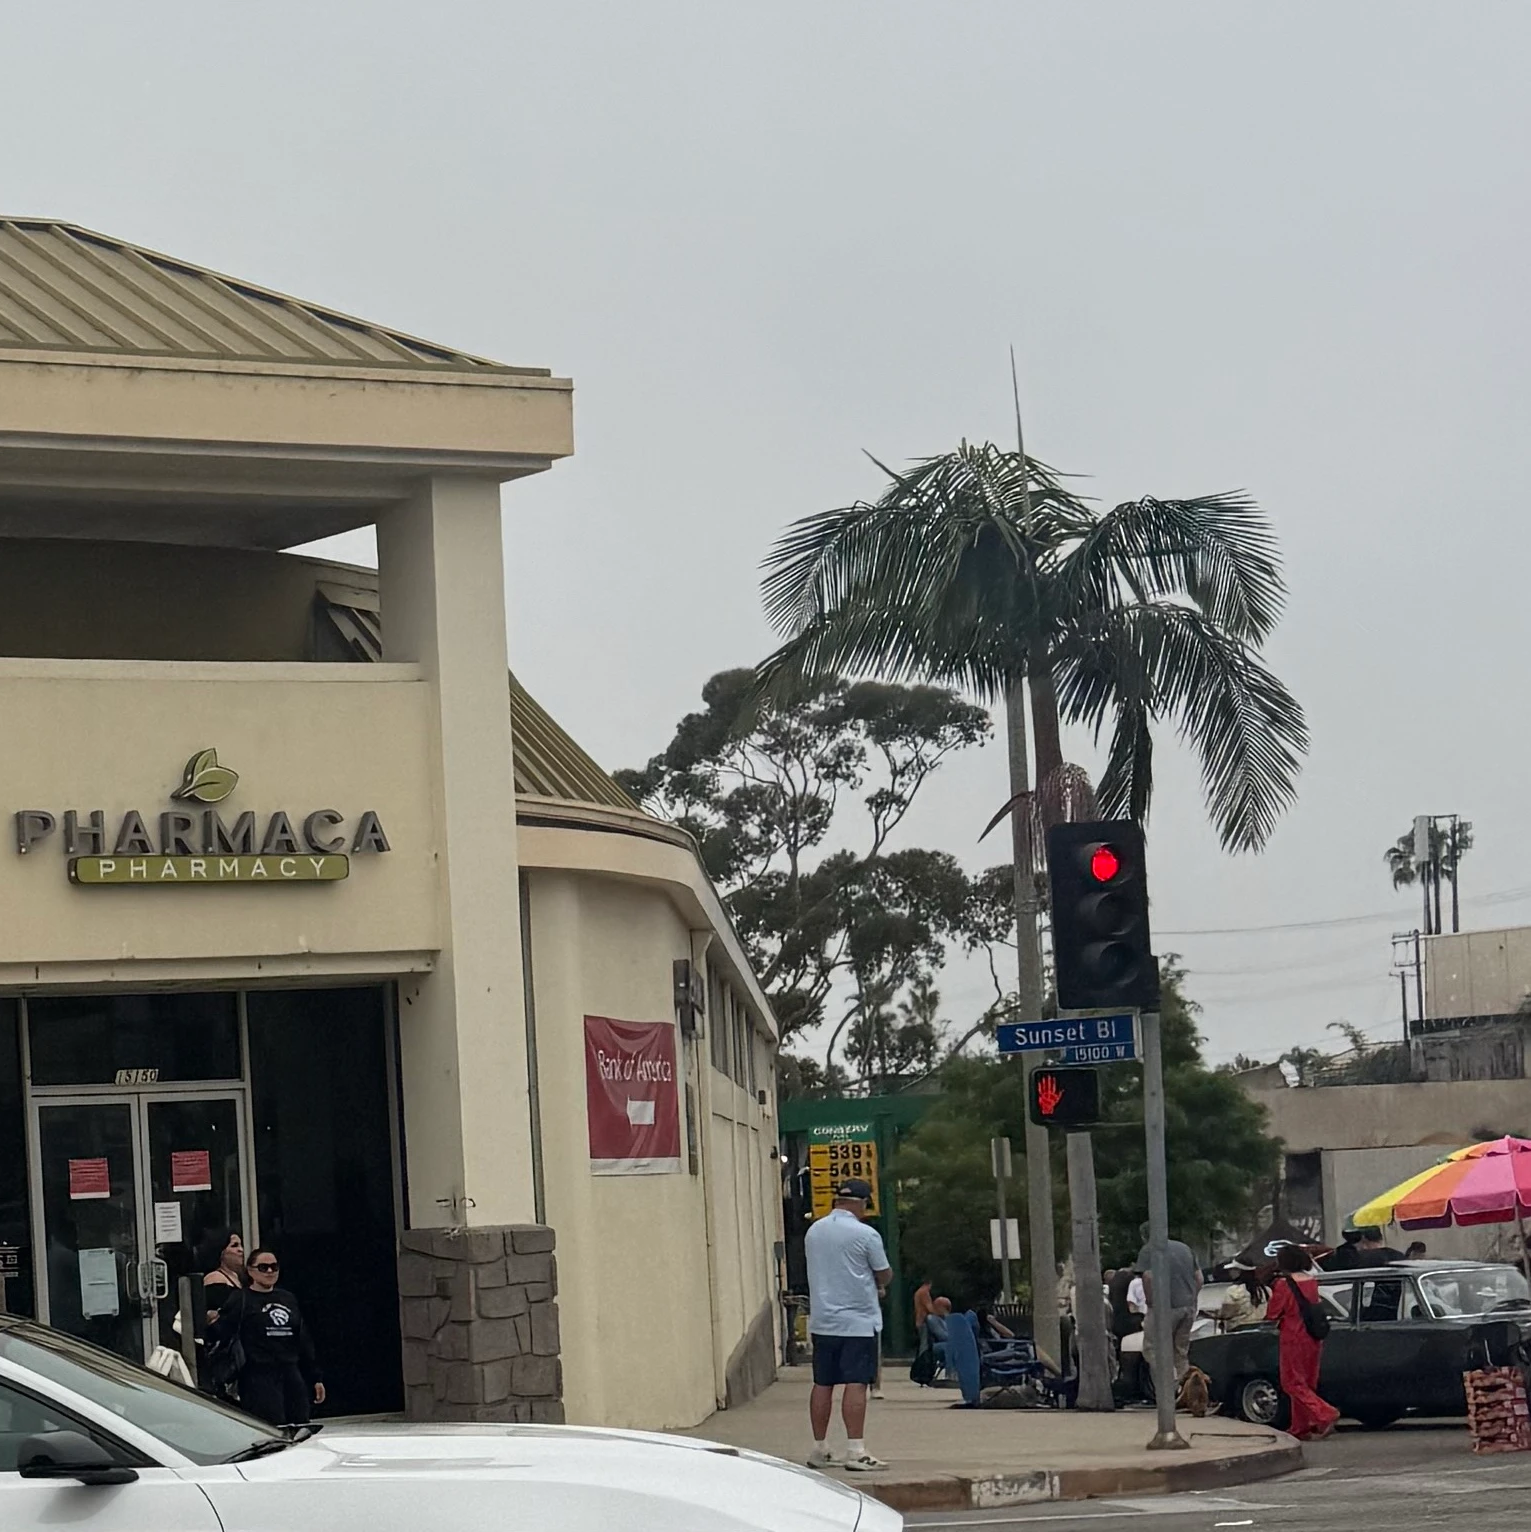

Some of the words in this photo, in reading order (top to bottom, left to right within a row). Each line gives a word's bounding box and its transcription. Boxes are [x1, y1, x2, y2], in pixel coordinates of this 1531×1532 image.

[15, 808, 391, 855] PHARMACA
[99, 857, 327, 879] PHARMACY
[1014, 1022, 1086, 1046] Sunset
[1097, 1020, 1116, 1039] Bl
[1075, 1046, 1110, 1061] 15100
[829, 1144, 862, 1160] 539
[829, 1161, 862, 1177] 549
